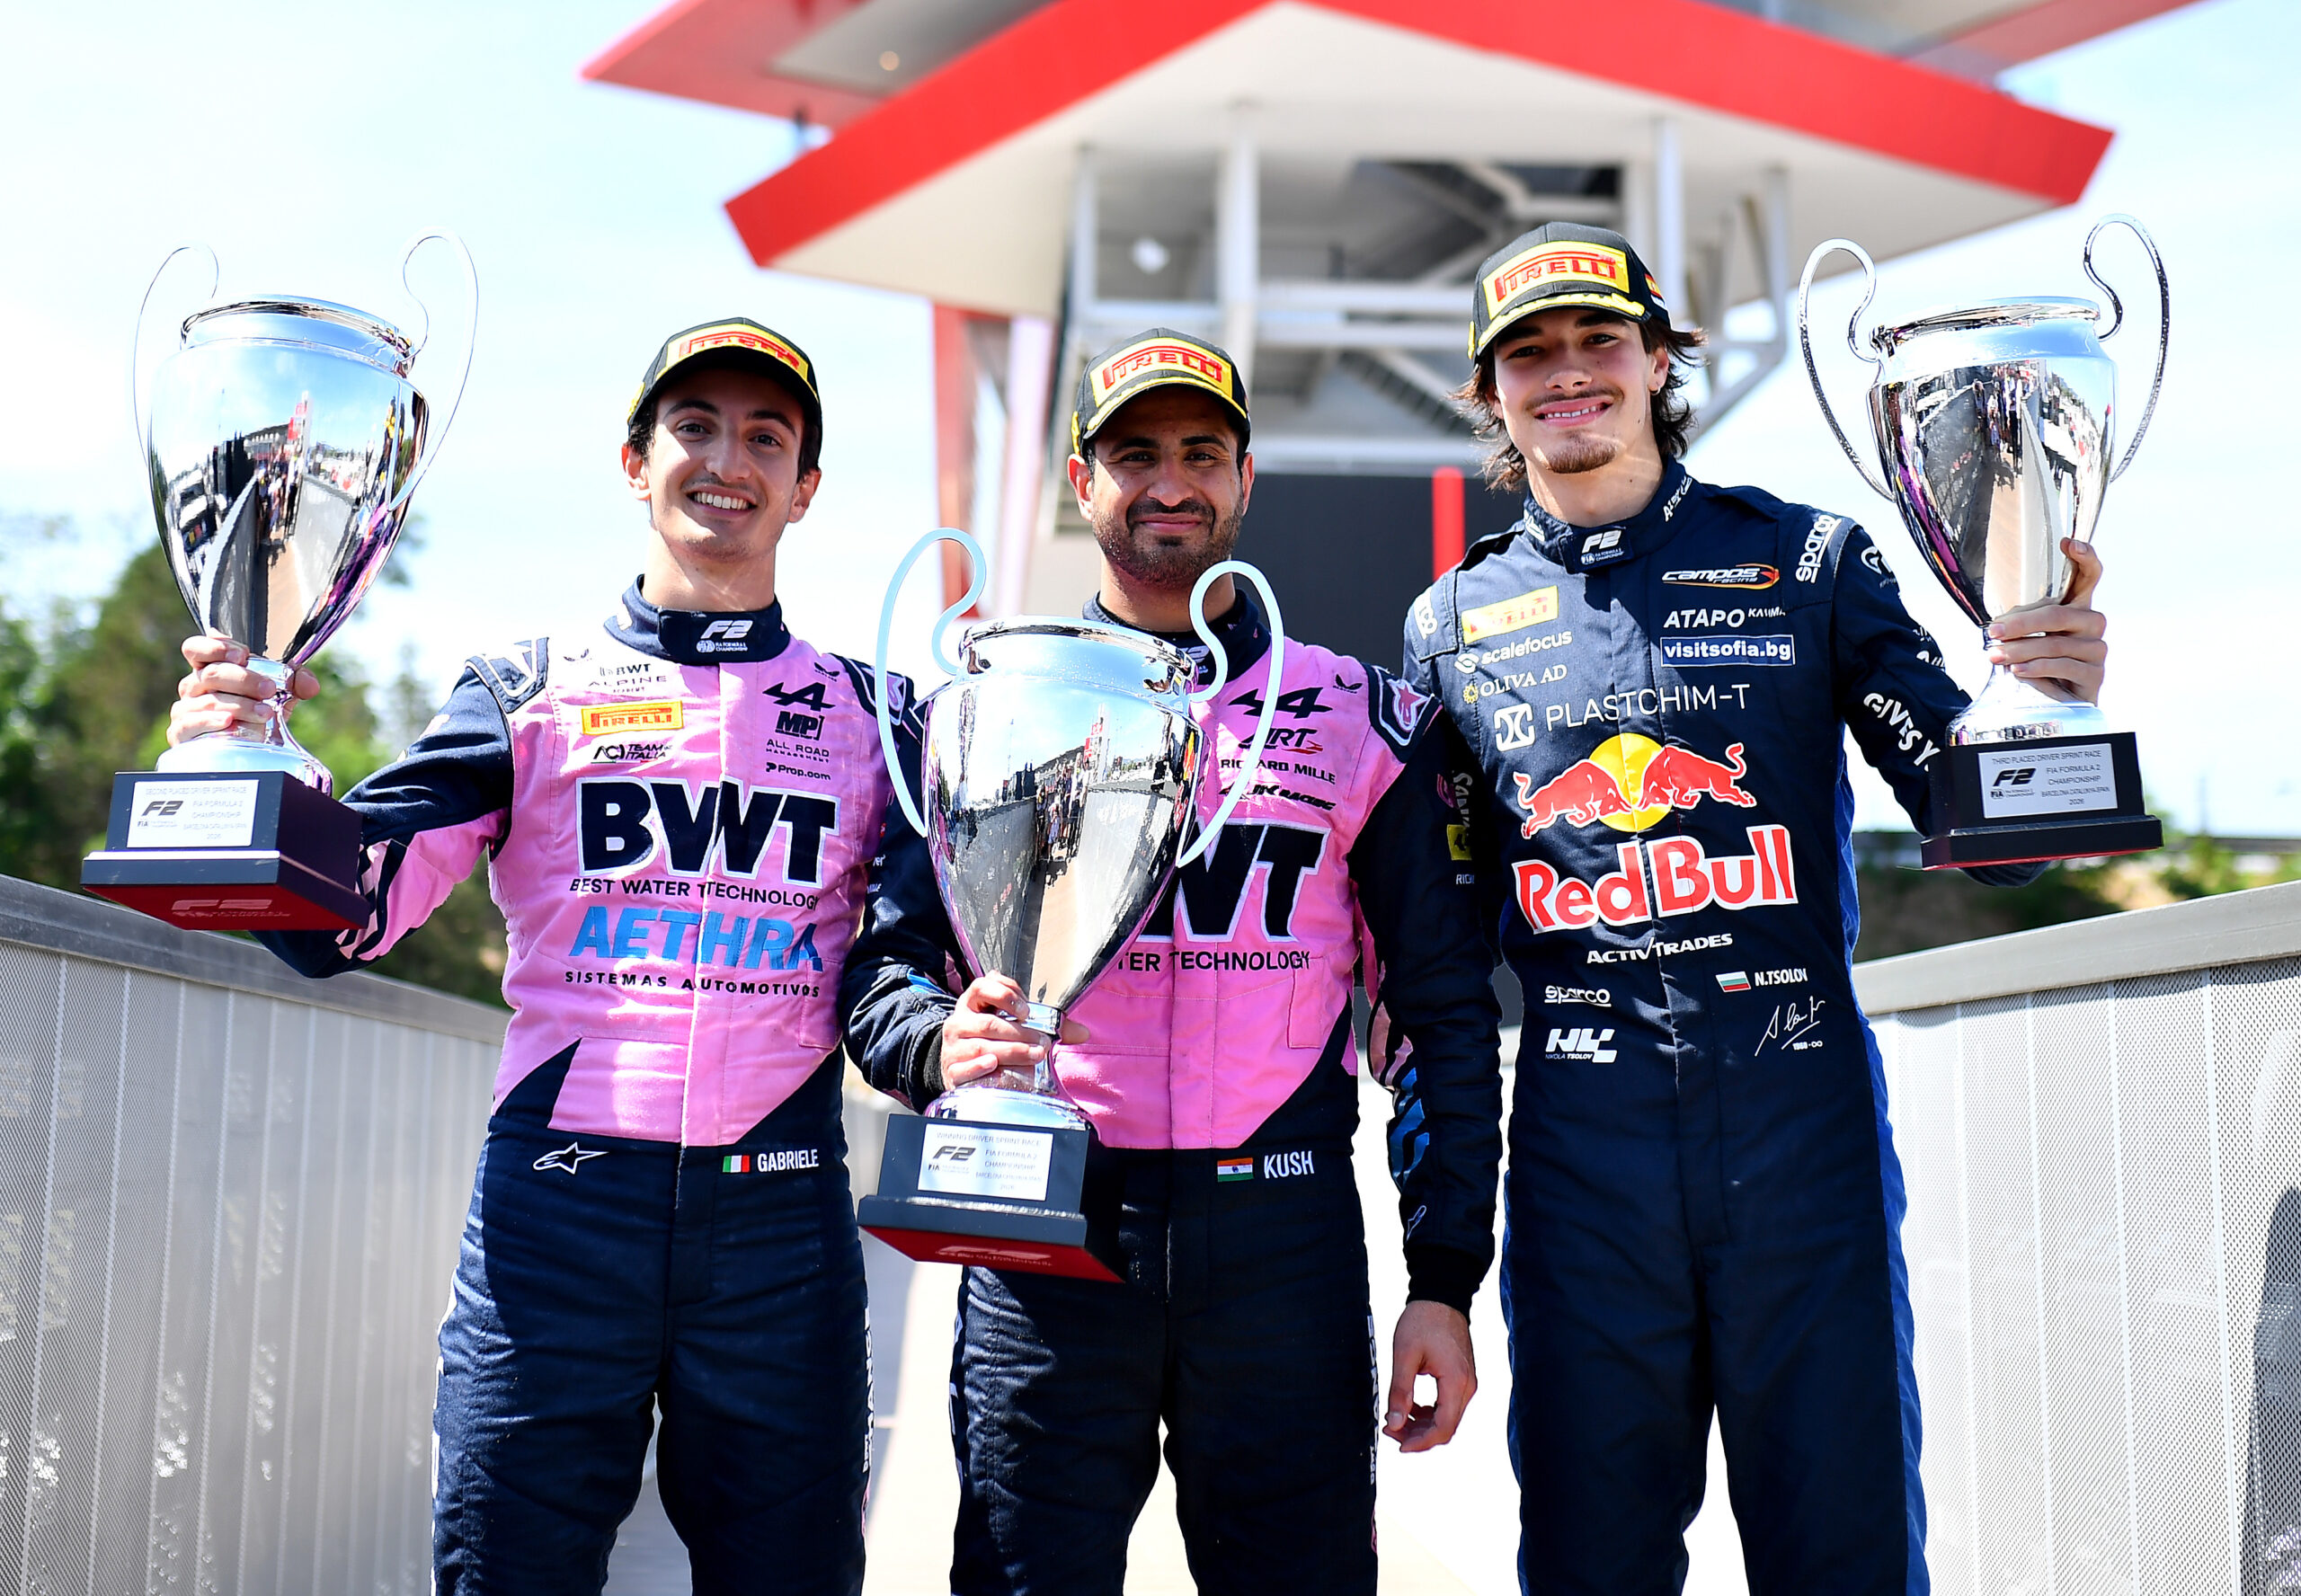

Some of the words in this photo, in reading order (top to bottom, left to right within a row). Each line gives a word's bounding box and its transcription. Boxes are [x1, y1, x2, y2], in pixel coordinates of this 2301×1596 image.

[1494, 251, 1617, 302] PIRELLI
[1103, 345, 1223, 390] PIRELLI
[1581, 529, 1622, 554] F2
[1662, 568, 1760, 582] campos
[700, 619, 753, 639] F2
[1481, 631, 1573, 665] scalefocus
[1664, 640, 1791, 661] visitsofia.bg
[1479, 671, 1538, 697] OLIVA
[1541, 664, 1568, 684] AD
[591, 707, 672, 728] PIRELLI
[1545, 683, 1751, 732] PLASTCHIM-T
[1863, 693, 1923, 750] GIVES
[1914, 740, 1941, 773] Y
[767, 739, 790, 749] ALL
[795, 744, 830, 758] ROAD
[778, 765, 831, 780] Prop.com
[1221, 758, 1289, 771] RICARD
[1294, 764, 1336, 785] MILLE
[1993, 767, 2036, 786] F2
[2059, 765, 2095, 773] FORMULA
[141, 800, 183, 816] F2
[576, 776, 840, 888] BWT
[1136, 816, 1331, 943] WT
[1512, 840, 1652, 935] Red
[1646, 824, 1798, 918] Bull
[569, 878, 615, 892] BEST
[621, 880, 690, 897] WATER
[697, 881, 821, 911] TECHNOLOGY
[569, 906, 823, 972] AETHRA
[1586, 933, 1733, 964] ACTIVTRADES
[1169, 951, 1310, 971] TECHNOLOGY
[565, 971, 667, 988] SISTEMAS
[681, 978, 820, 998] AUTOMOTIVOS
[1544, 985, 1612, 1007] sparco
[758, 1149, 819, 1172] GABRIELE
[932, 1146, 977, 1161] F2
[1264, 1150, 1315, 1179] KUSH
